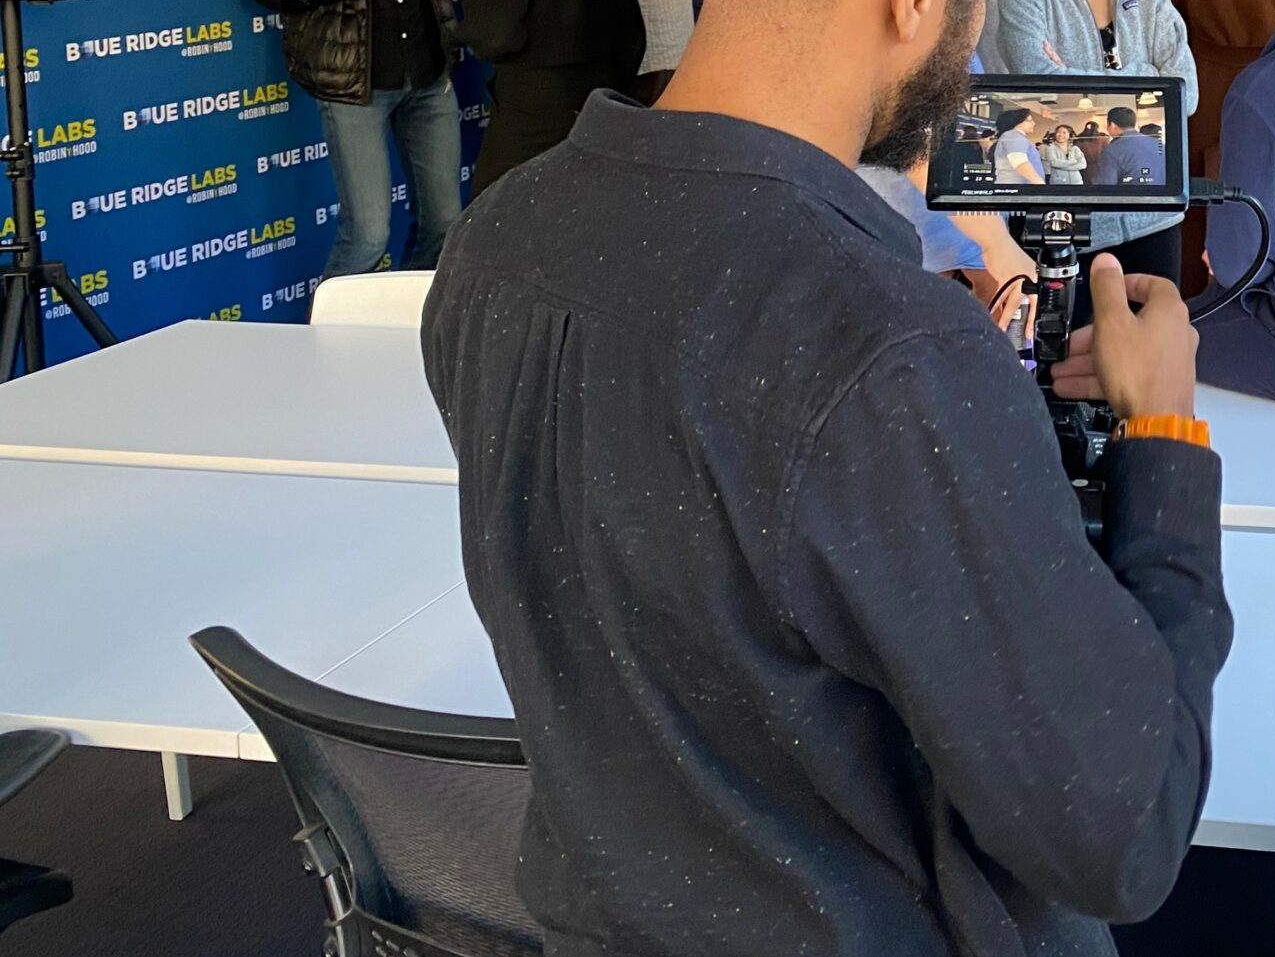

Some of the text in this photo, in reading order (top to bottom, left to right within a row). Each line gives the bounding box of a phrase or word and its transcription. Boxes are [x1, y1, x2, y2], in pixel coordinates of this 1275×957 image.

[126, 28, 183, 52] RIDGE
[187, 21, 231, 43] LABS
[183, 91, 240, 118] RIDGE
[243, 83, 287, 106] LABS
[38, 119, 96, 147] LABS
[132, 176, 188, 204] RIDGE
[191, 165, 237, 195] LABS
[192, 230, 247, 262] RIDGE
[251, 217, 295, 249] LABS
